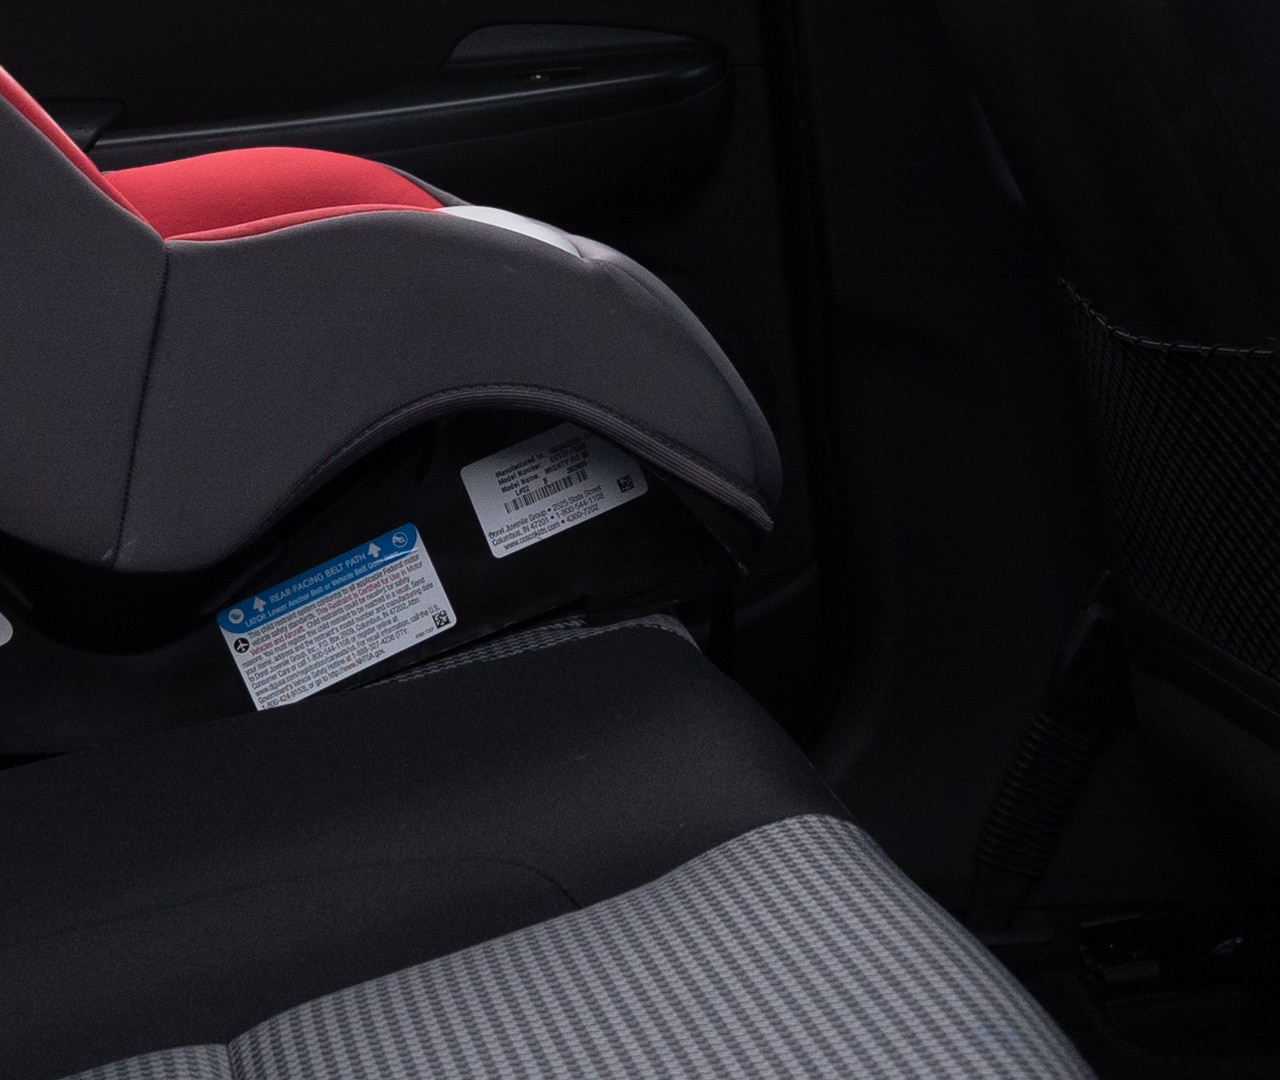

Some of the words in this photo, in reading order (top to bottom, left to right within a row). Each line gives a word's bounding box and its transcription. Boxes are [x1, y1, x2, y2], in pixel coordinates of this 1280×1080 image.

[494, 456, 535, 478] Manufactured
[497, 472, 517, 485] Model
[500, 480, 520, 493] Model
[543, 458, 569, 474] MIGHTY
[491, 527, 523, 547] Columbus,
[522, 524, 530, 533] IN
[529, 516, 549, 529] 47201
[504, 516, 528, 532] Juvenile
[528, 508, 548, 523] Group
[567, 492, 584, 504] State
[583, 484, 602, 497] Street
[259, 622, 274, 634] child
[273, 611, 297, 627] restraint
[296, 602, 317, 617] system
[355, 570, 384, 589] applicable
[382, 560, 404, 575] Federal
[403, 553, 419, 565] motor
[267, 602, 288, 617] Lower
[286, 591, 310, 608] Anchor
[309, 584, 324, 597] Belt
[323, 582, 332, 590] or
[330, 570, 354, 586] Vehicle
[353, 563, 367, 575] Belt
[268, 572, 324, 604] REAR-FACING
[324, 562, 345, 578] BELT
[344, 552, 367, 568] PATH
[251, 673, 278, 690] Consumer
[277, 666, 291, 677] Care
[295, 658, 306, 668] call
[356, 625, 376, 640] register
[375, 618, 392, 630] online
